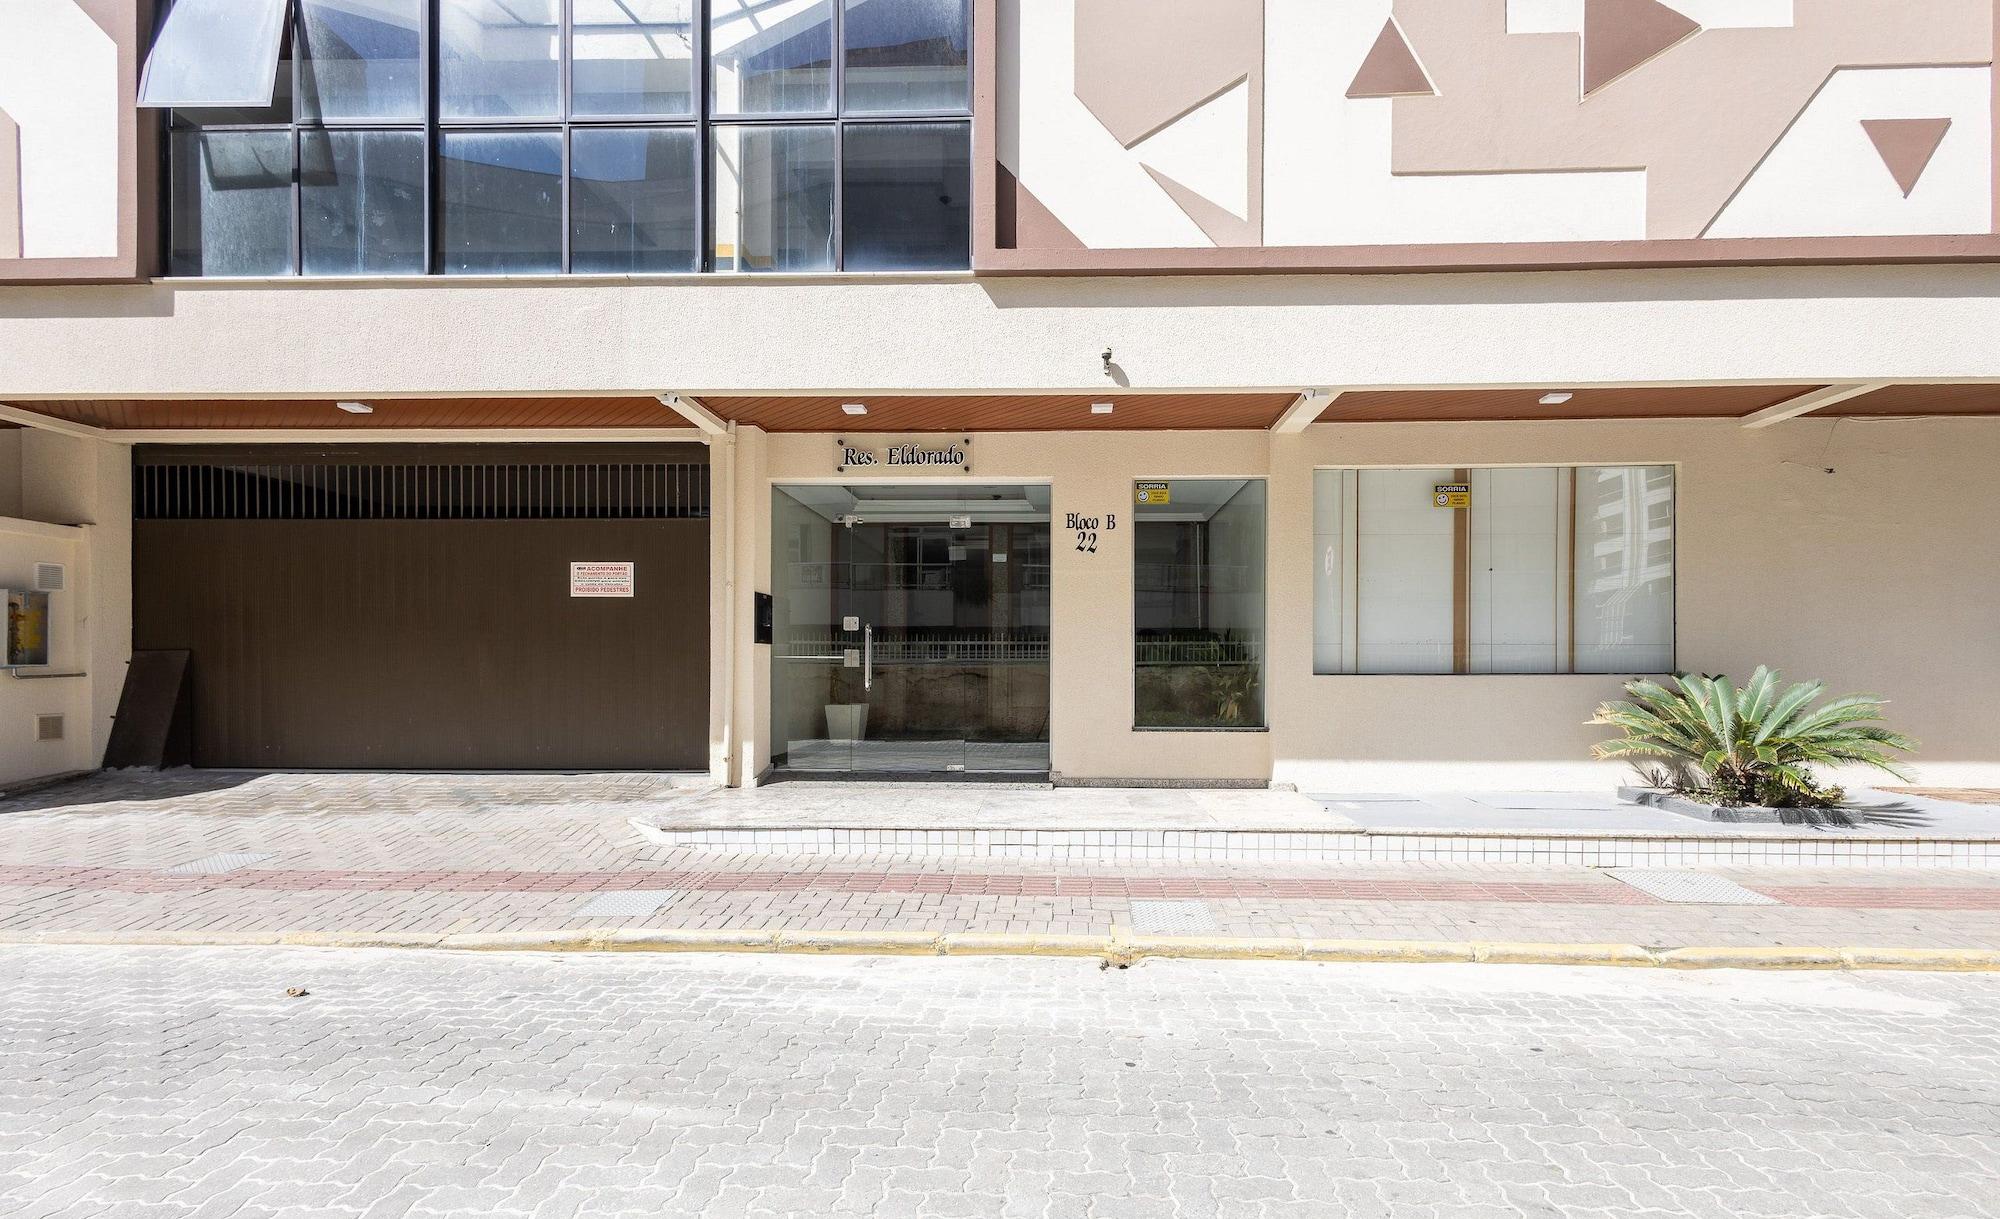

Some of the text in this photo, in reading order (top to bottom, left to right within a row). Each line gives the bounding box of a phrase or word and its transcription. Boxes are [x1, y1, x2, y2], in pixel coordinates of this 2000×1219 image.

[843, 444, 965, 466] Res. Eldorado
[1065, 512, 1116, 531] Bloco B
[1075, 531, 1098, 554] 22
